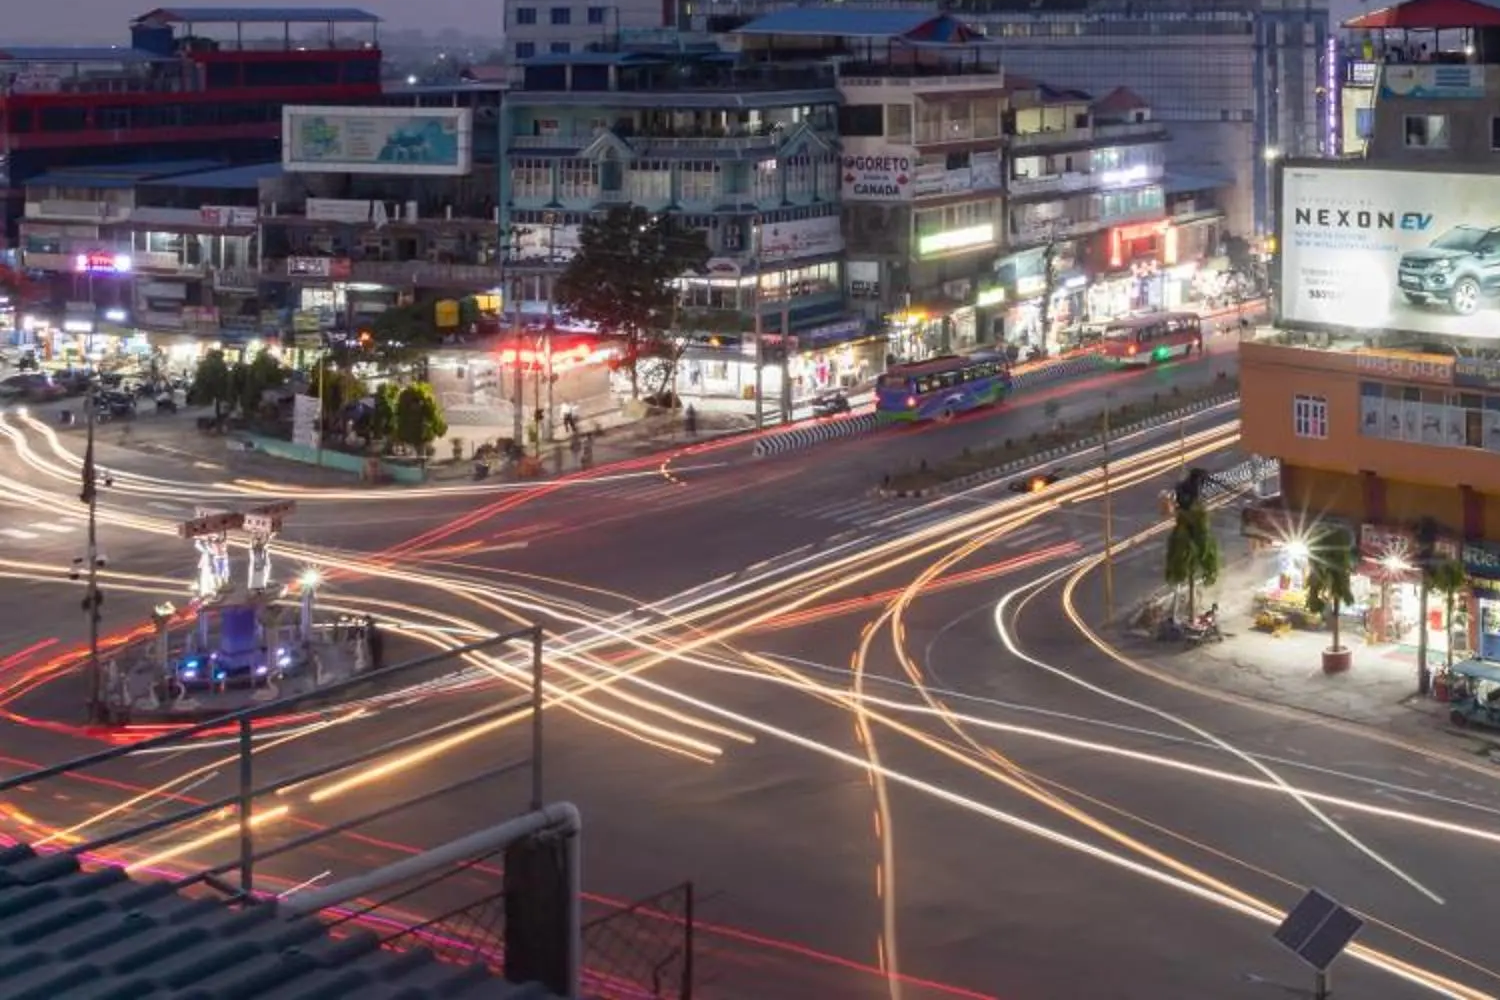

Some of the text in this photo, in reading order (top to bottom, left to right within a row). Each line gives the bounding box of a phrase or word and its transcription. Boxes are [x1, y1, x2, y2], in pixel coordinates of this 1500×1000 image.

[856, 156, 909, 171] GORETO
[854, 183, 900, 195] CANADA
[1295, 207, 1432, 230] NEXON EV
